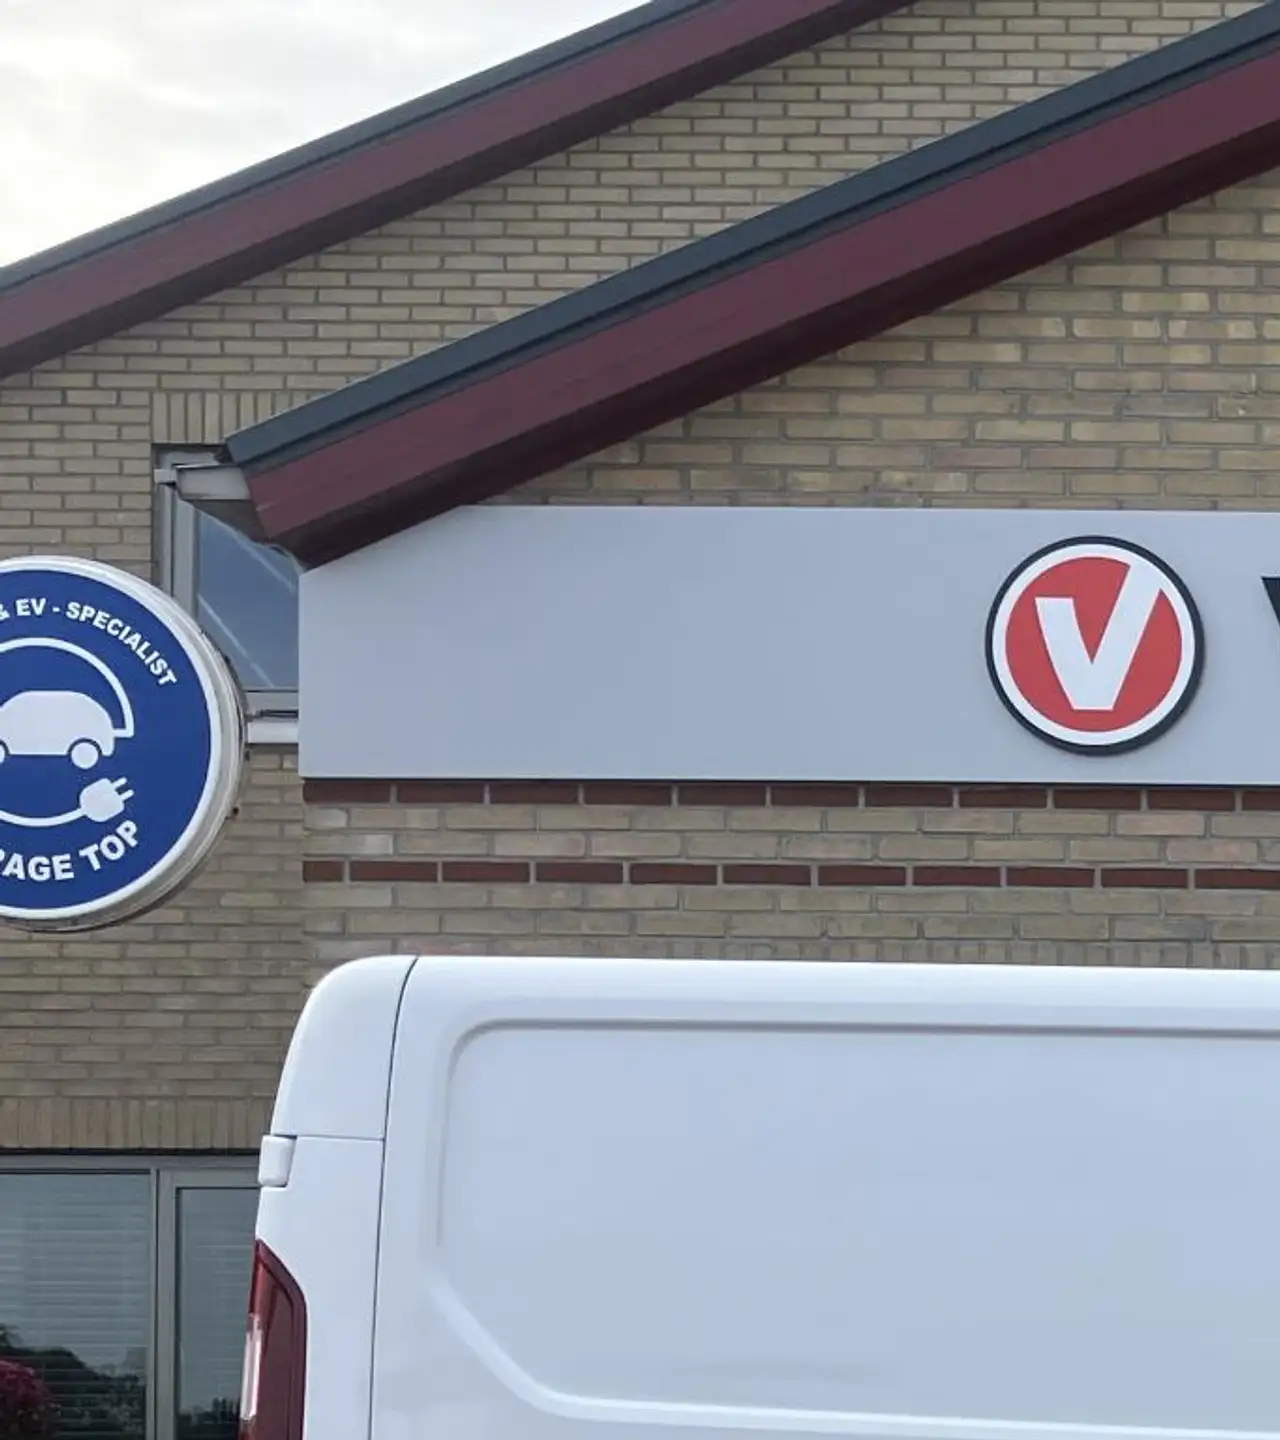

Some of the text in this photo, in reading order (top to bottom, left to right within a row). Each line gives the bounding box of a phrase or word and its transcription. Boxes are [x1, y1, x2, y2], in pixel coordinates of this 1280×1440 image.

[16, 598, 46, 616] EV
[67, 602, 177, 685] SPECIALIST
[0, 820, 138, 881] AGE TOP
